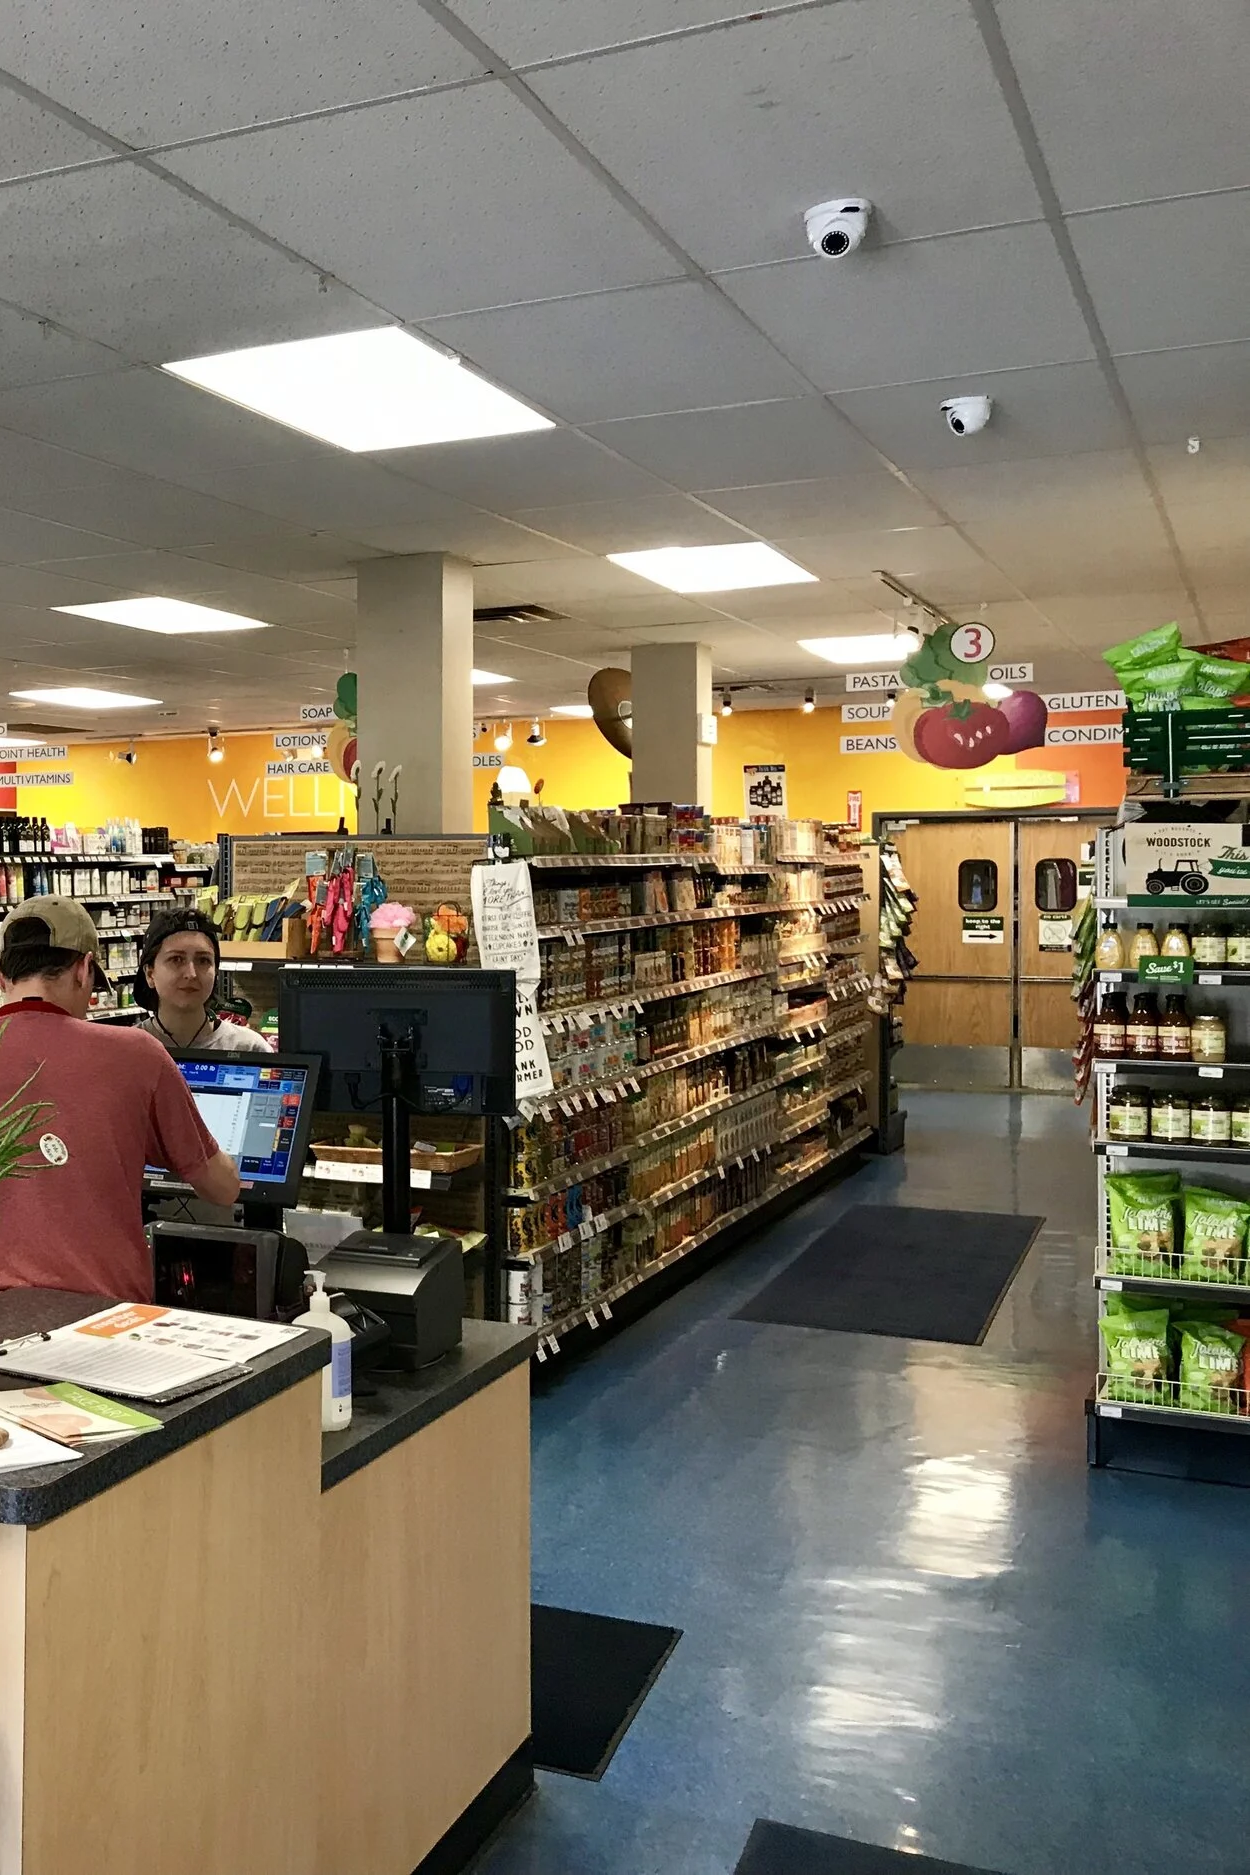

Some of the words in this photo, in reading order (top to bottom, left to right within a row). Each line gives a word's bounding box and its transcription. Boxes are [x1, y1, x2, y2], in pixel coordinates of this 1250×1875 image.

[963, 627, 983, 659] 3
[989, 667, 1027, 680] OILS
[852, 675, 899, 689] PASTA
[1048, 694, 1119, 710] GLUTEN
[301, 707, 333, 719] SOAP
[847, 706, 890, 720] SOUP
[275, 734, 327, 747] LOTIONS
[846, 737, 897, 751] BEANS
[27, 748, 66, 759] HEALTH
[267, 763, 296, 775] HAIR
[299, 762, 330, 774] CARE
[1146, 837, 1211, 848] WOODSTOCK
[1217, 845, 1249, 861] This
[1145, 962, 1173, 974] Save
[1173, 961, 1185, 974] $1
[1127, 1218, 1167, 1232] LIME
[1194, 1224, 1237, 1240] LIME
[1199, 1356, 1239, 1371] LIME
[65, 1390, 94, 1407] TAKE
[98, 1404, 128, 1419] PART
